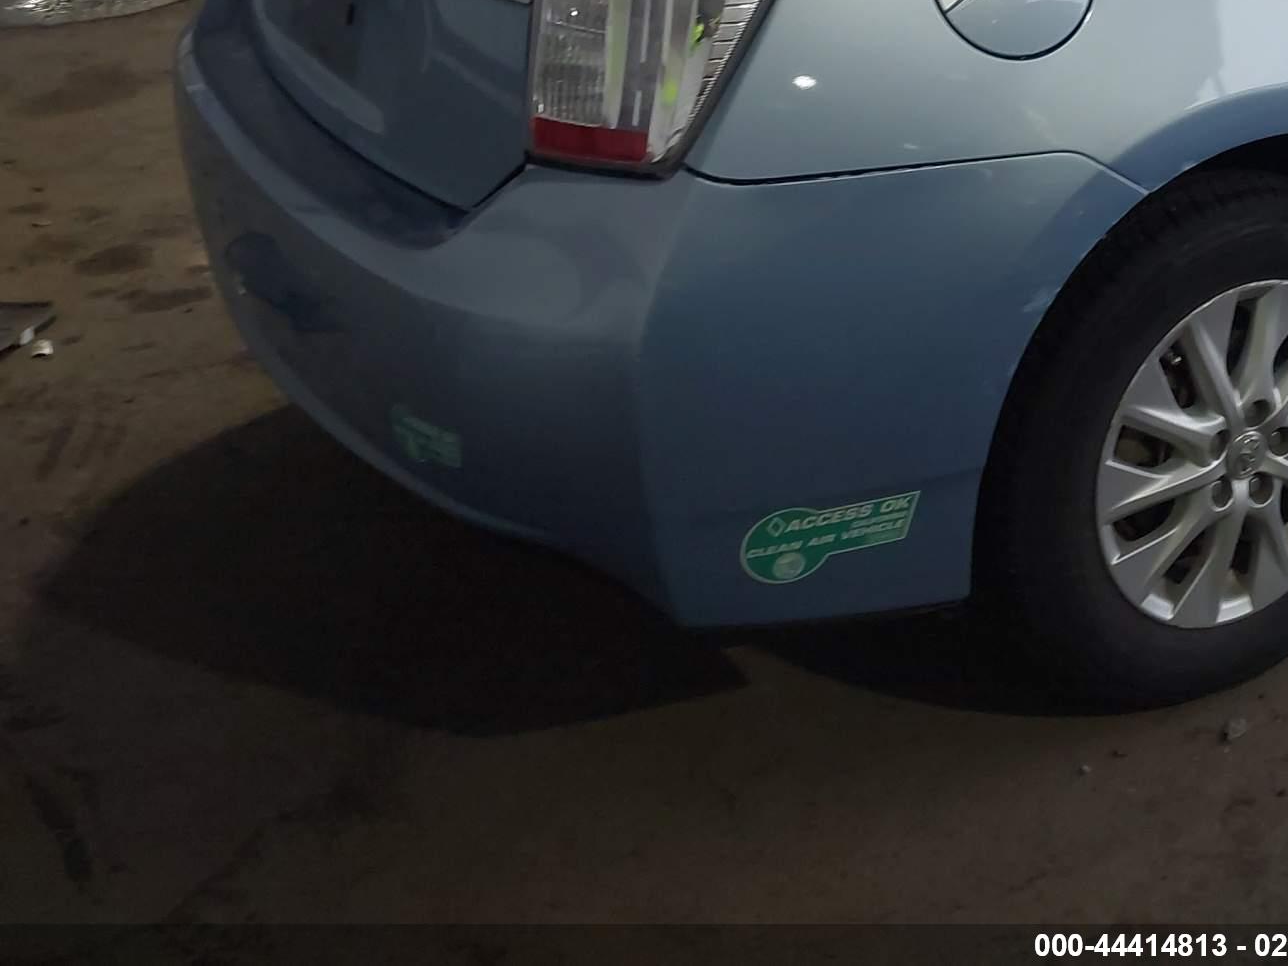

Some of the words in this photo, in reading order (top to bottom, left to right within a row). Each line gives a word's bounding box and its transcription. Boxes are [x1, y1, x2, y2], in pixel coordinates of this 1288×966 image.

[784, 504, 875, 533] ACCESS
[880, 496, 913, 513] OK
[747, 540, 804, 560] CLEAN
[841, 519, 906, 540] VEHICLE
